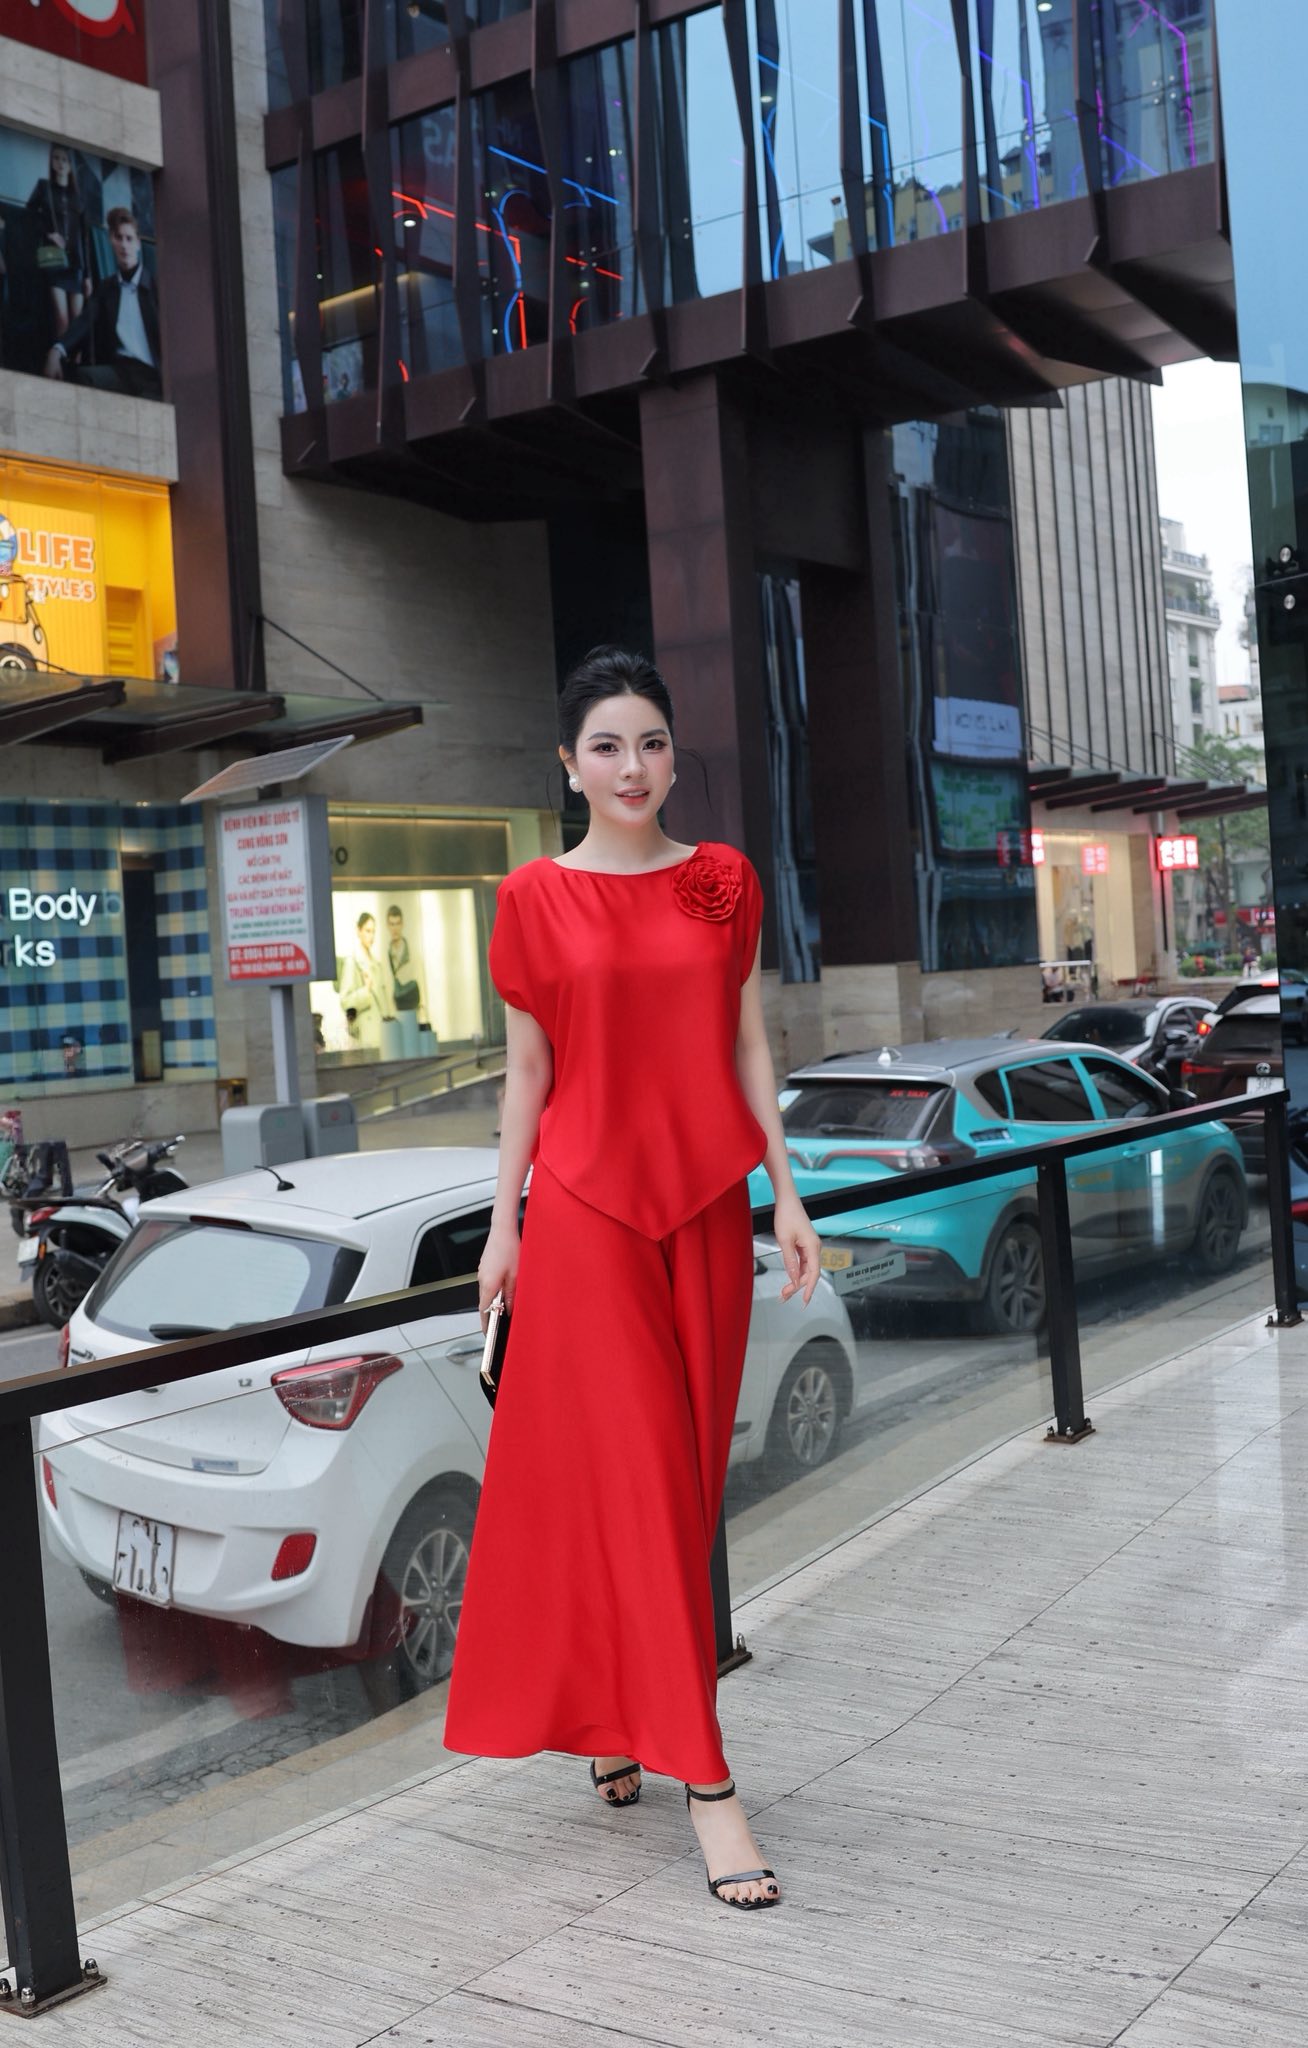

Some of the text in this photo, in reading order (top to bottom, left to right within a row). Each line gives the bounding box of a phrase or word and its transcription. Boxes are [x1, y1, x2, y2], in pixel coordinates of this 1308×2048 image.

[18, 529, 95, 573] LIFE
[25, 575, 96, 602] STYLES
[8, 887, 97, 926] Body
